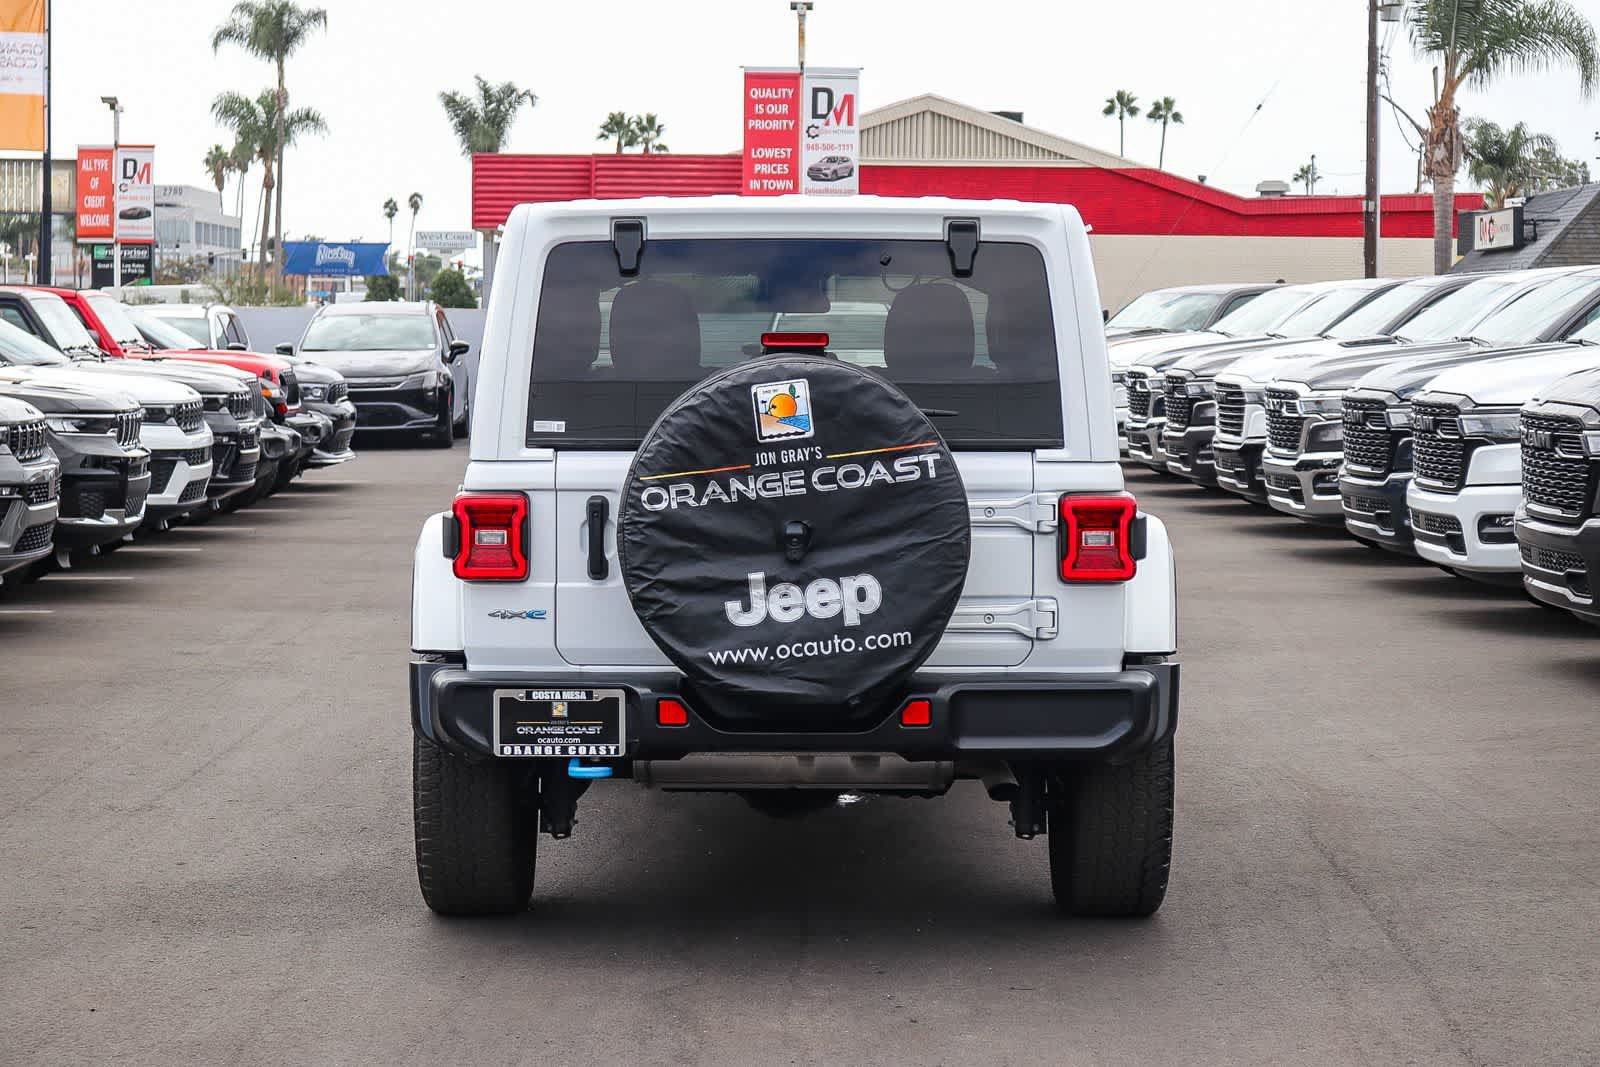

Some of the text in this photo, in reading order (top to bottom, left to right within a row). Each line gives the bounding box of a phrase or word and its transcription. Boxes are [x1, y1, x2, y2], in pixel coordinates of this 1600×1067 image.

[750, 88, 794, 99] QUALITY
[755, 103, 789, 115] IS OUR
[748, 119, 794, 130] PRIORITY
[751, 148, 792, 158] LOWEST
[82, 159, 109, 171] ALL TYPE
[754, 163, 789, 174] PRICES
[90, 177, 99, 189] OF
[750, 179, 794, 190] IN TOWN
[84, 195, 106, 208] CREDIT
[80, 214, 110, 227] WELCOME
[754, 446, 823, 467] JON GRAY'S
[640, 453, 941, 511] ORANGE COAST
[724, 571, 883, 627] Jeep
[708, 631, 912, 665] www.ocauto.com
[532, 690, 587, 700] COSTA MESA
[516, 726, 603, 734] ORANGE COAST
[537, 736, 581, 744] ocauto.com
[503, 746, 617, 755] ORANGE COAST
